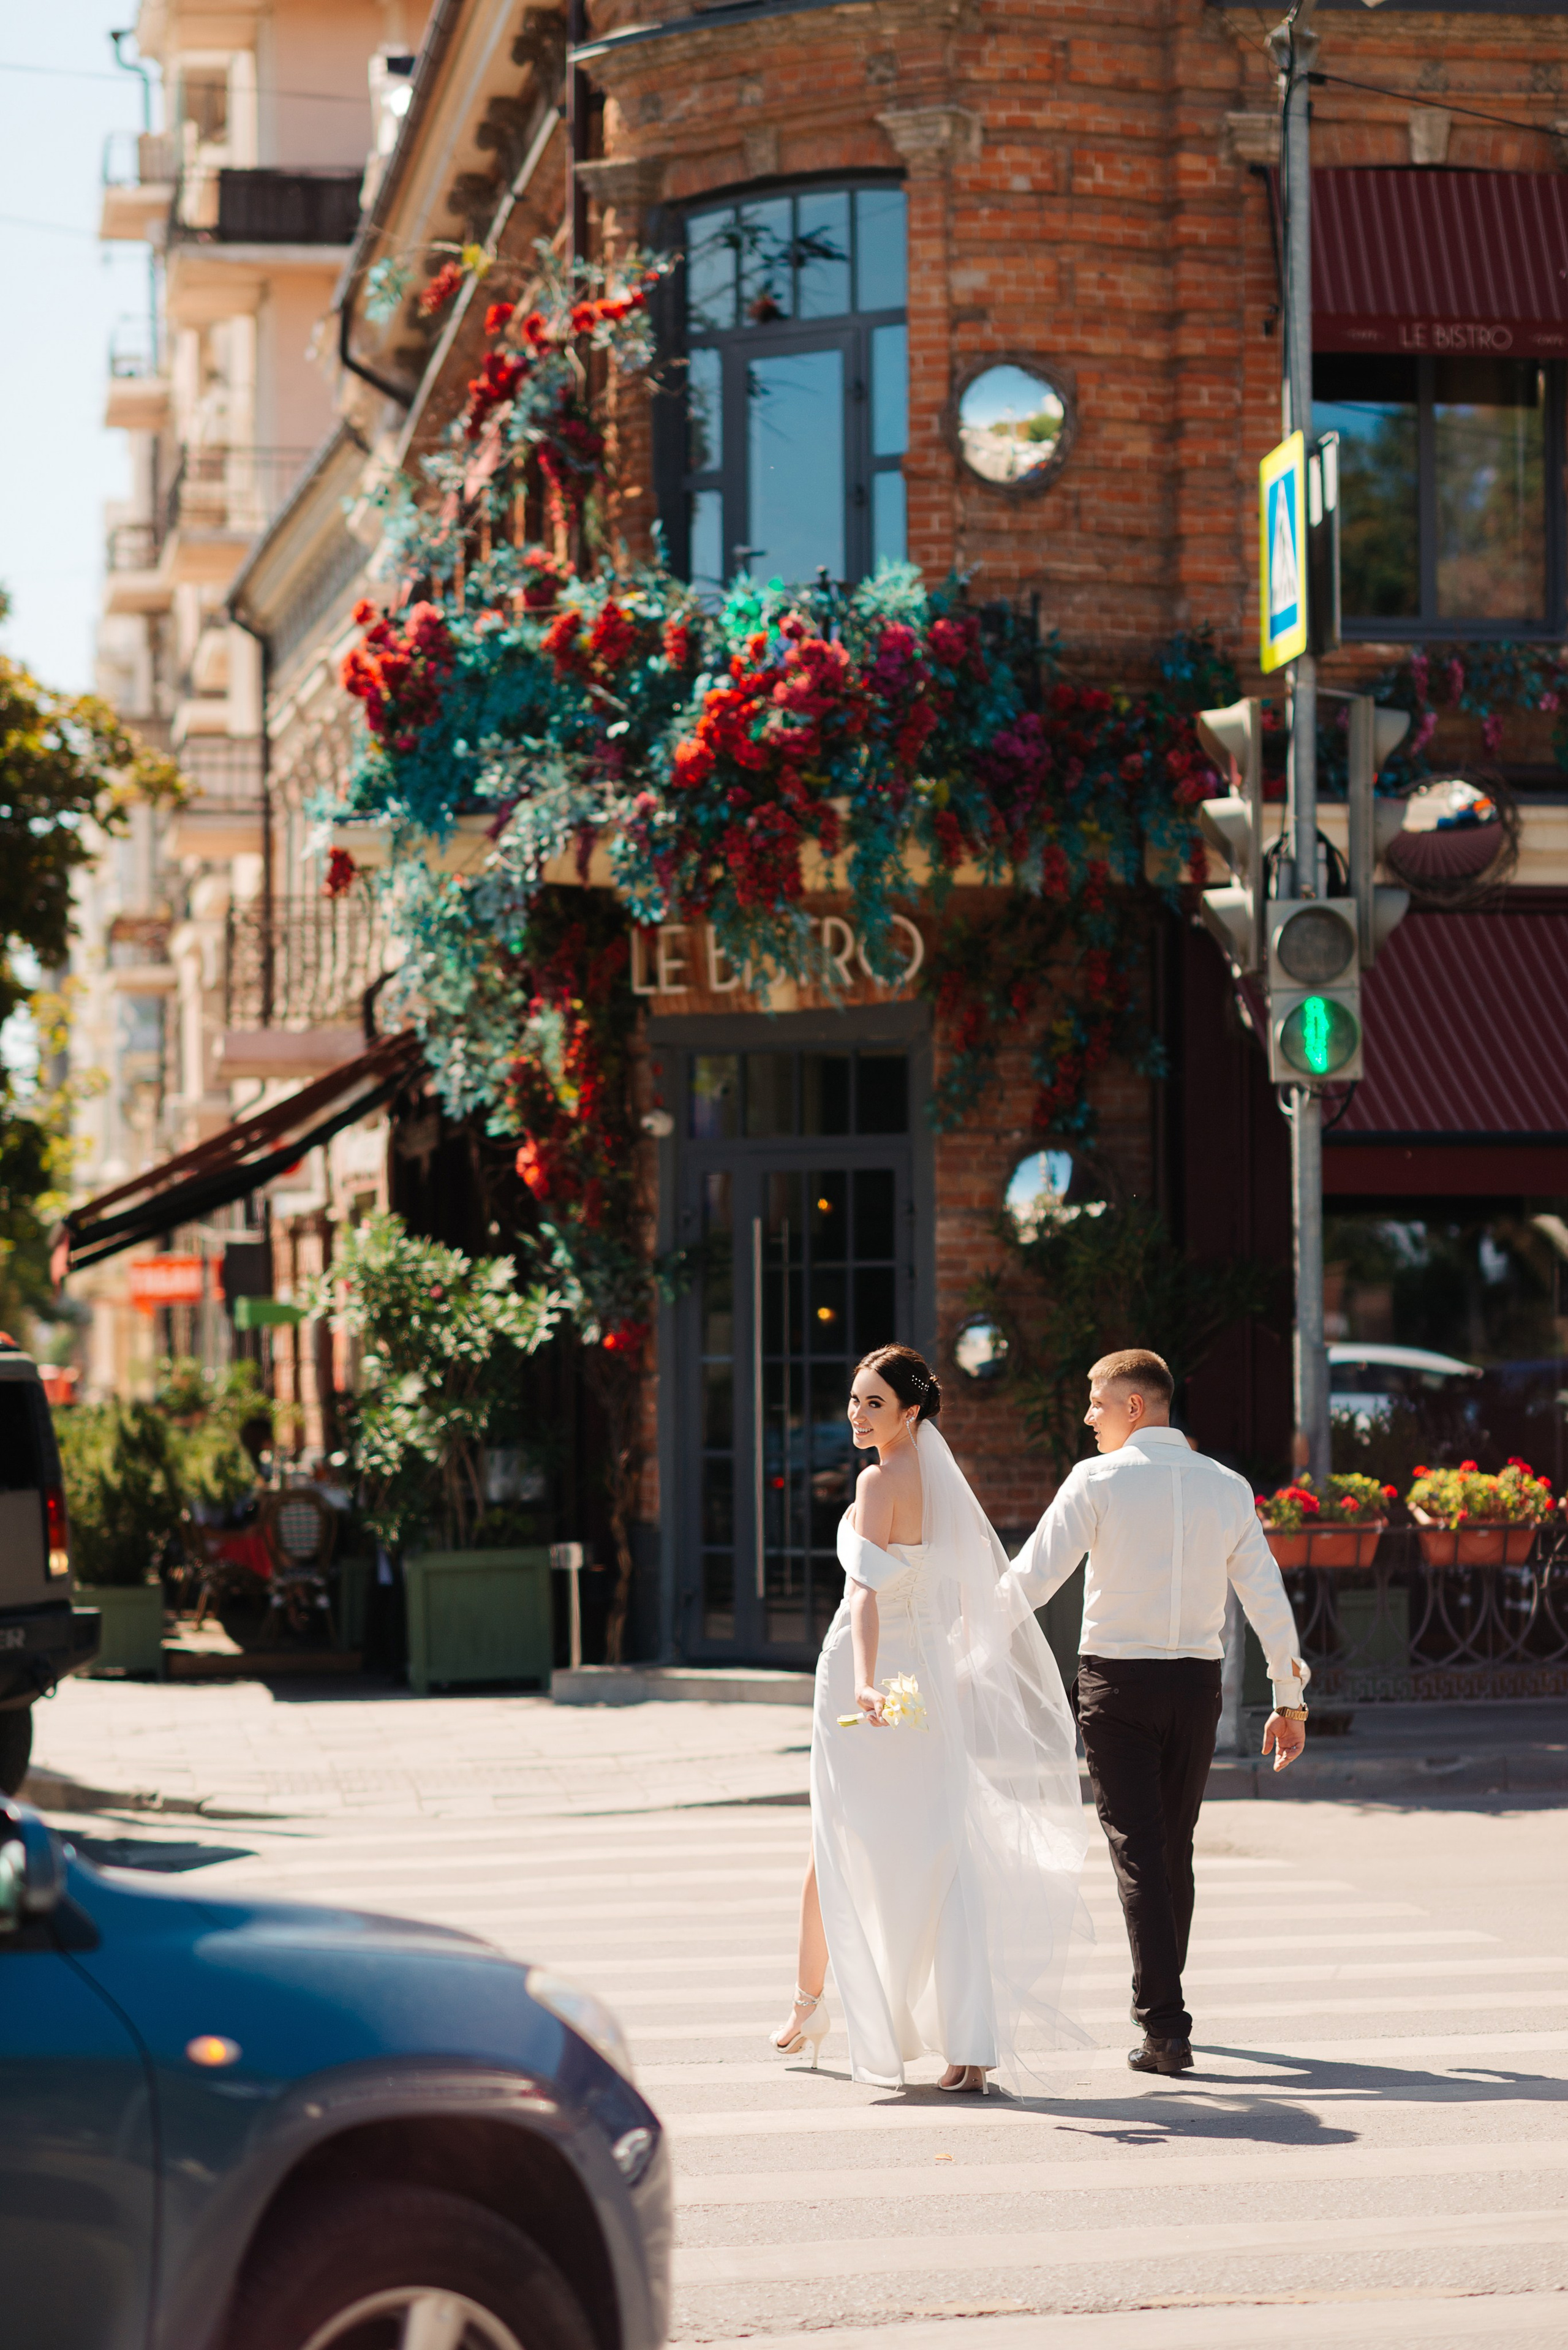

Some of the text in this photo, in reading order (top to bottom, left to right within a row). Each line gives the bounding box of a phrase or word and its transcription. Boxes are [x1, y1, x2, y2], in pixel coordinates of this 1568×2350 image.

[1398, 323, 1427, 350] LE
[1433, 324, 1513, 351] BISTRO
[630, 924, 687, 995] LE
